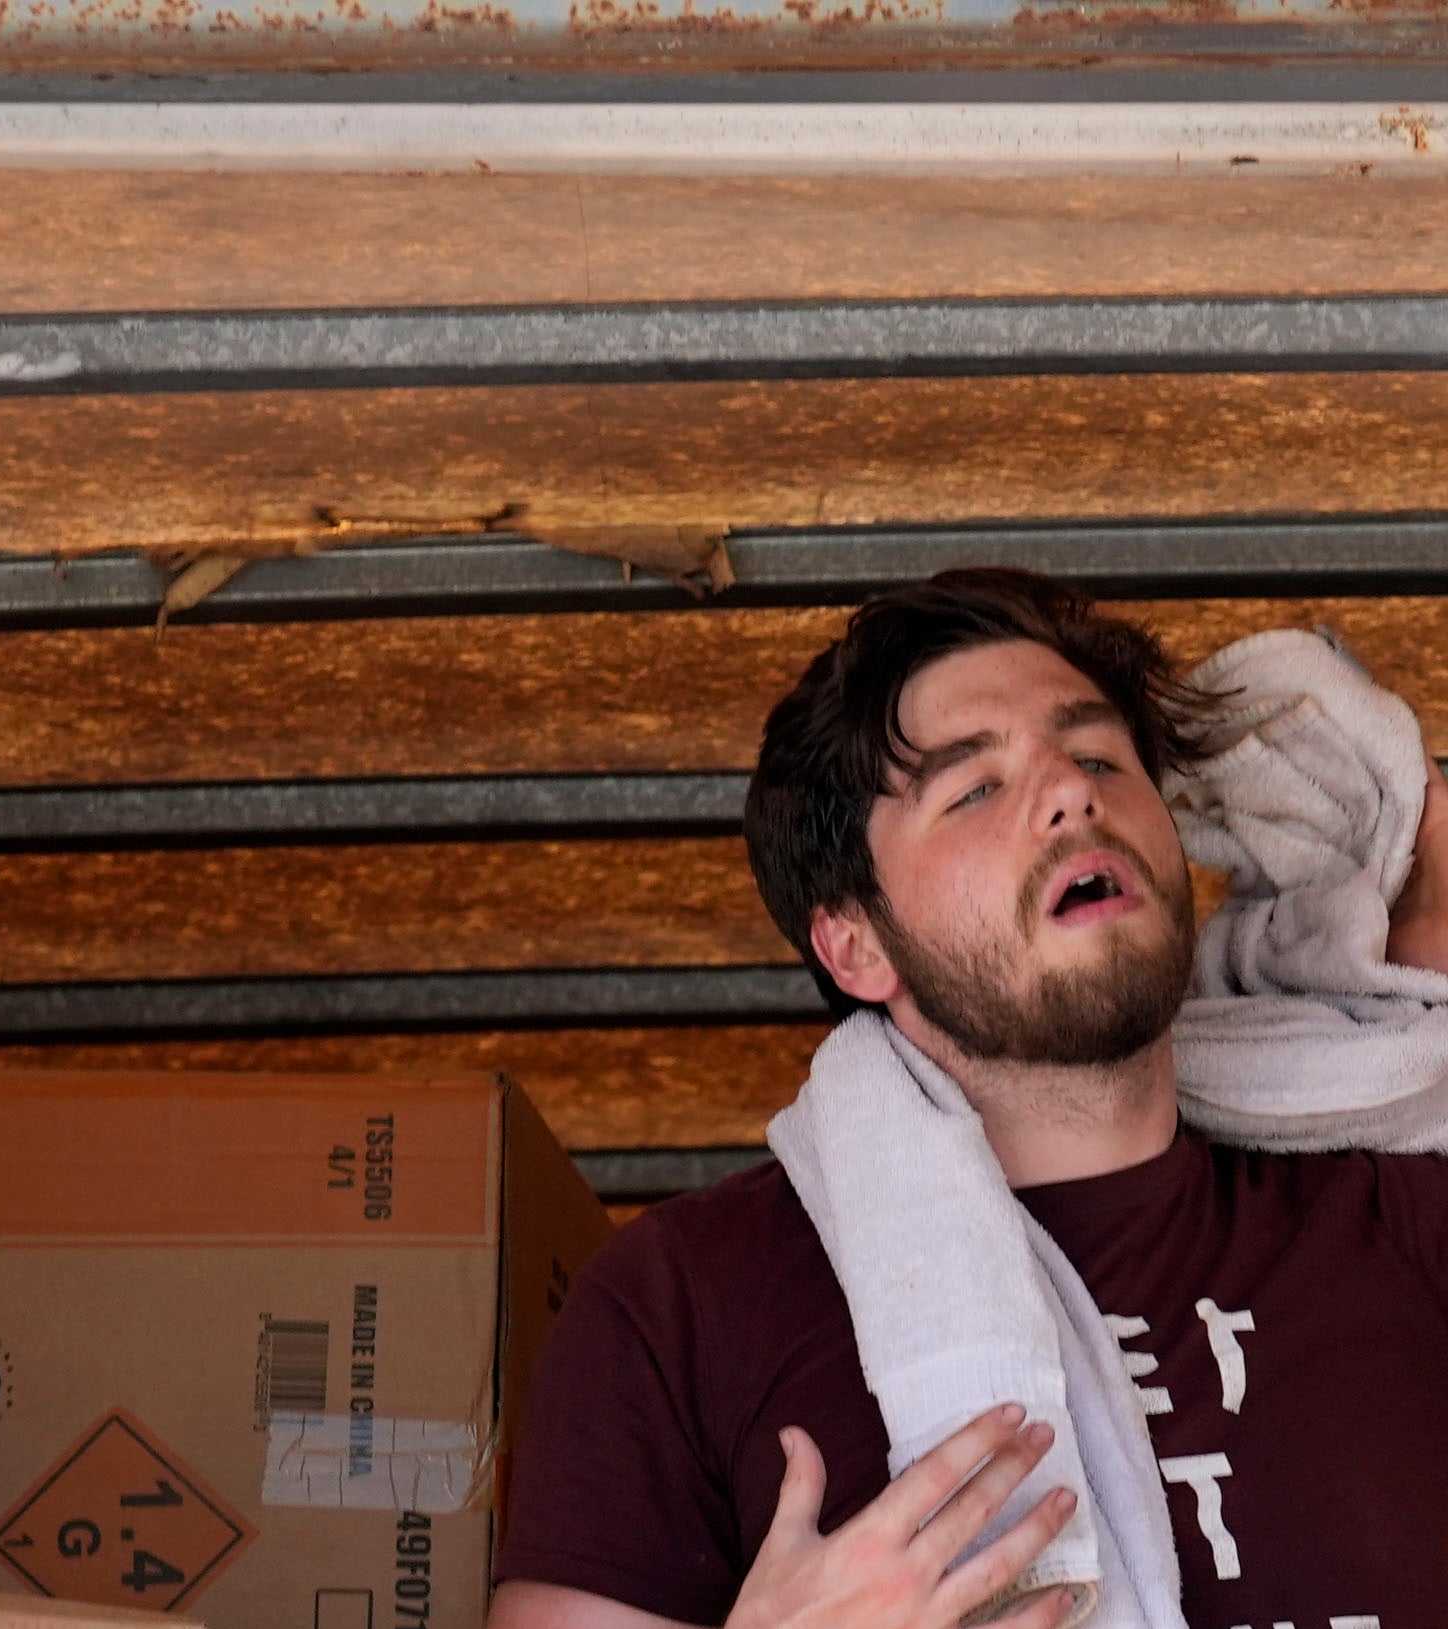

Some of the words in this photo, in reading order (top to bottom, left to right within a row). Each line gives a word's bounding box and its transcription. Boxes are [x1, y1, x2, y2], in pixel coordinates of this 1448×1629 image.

[328, 1146, 355, 1188] 4/1
[364, 1114, 393, 1219] TS5506
[352, 1286, 377, 1356] MADE
[1102, 1298, 1255, 1414] ET
[351, 1363, 374, 1389] IN
[6, 1533, 34, 1551] 1
[58, 1519, 101, 1557] G
[120, 1480, 184, 1592] 1.4
[1159, 1452, 1233, 1580] T
